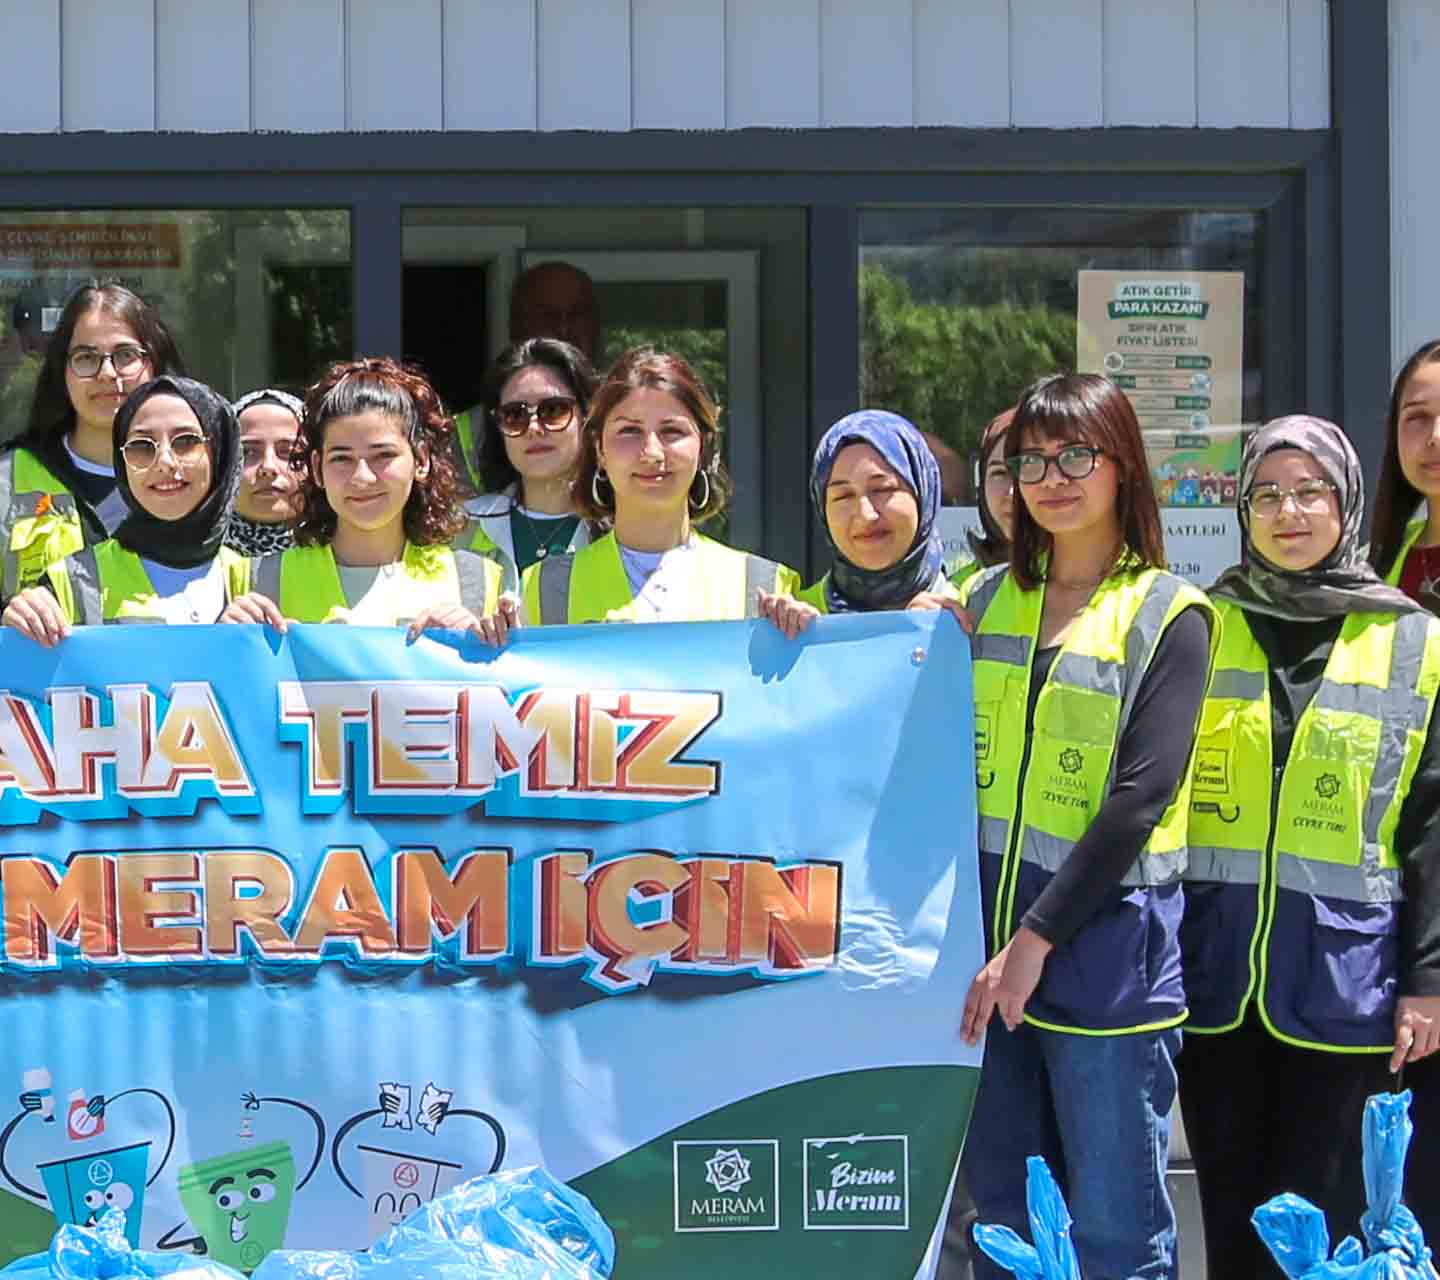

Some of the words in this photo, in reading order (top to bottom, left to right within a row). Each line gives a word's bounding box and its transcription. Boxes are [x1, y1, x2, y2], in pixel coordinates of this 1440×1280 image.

[1114, 302, 1150, 314] PARA
[278, 681, 723, 800] TEMİZ
[534, 848, 844, 986] İÇİN
[829, 1162, 897, 1188] Bizim
[691, 1197, 766, 1216] MERAM
[811, 1189, 902, 1213] Meram
